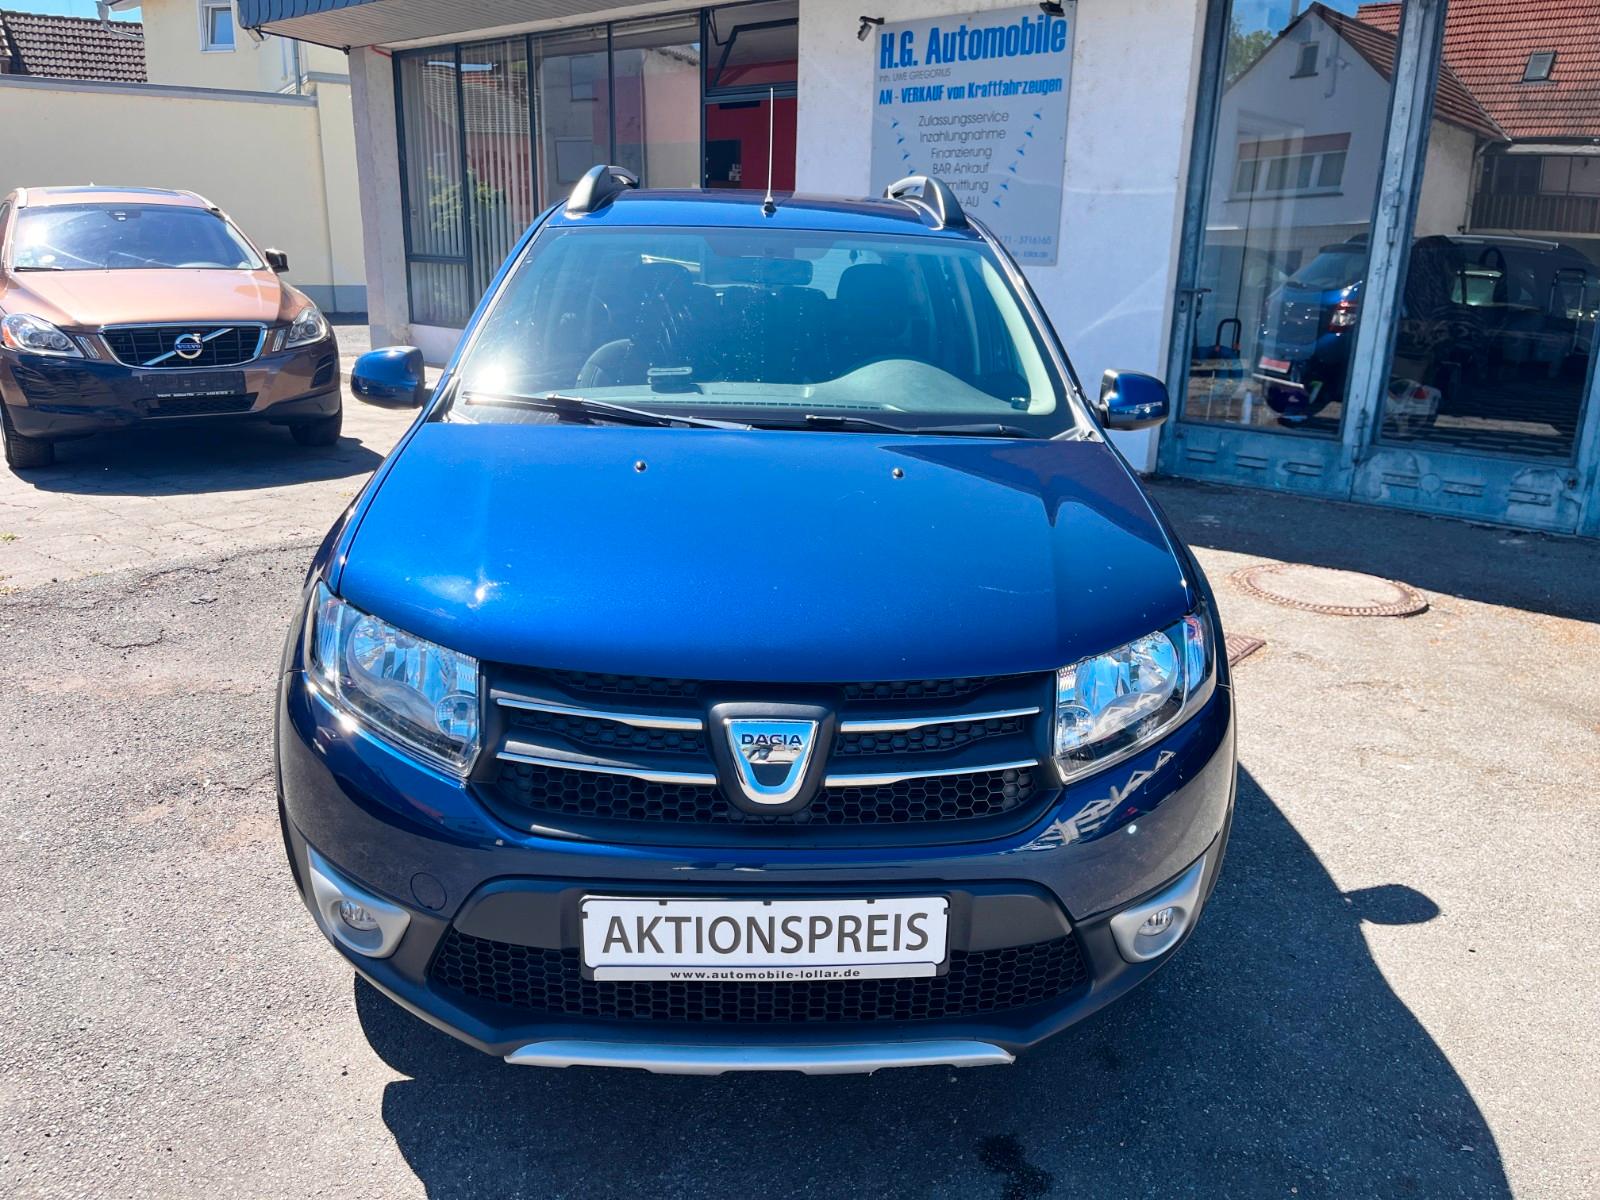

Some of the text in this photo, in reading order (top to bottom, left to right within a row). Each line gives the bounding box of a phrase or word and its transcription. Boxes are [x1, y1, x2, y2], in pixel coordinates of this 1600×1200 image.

[880, 14, 1067, 69] H.G. Automobile
[909, 68, 952, 80] GREGORIUS
[879, 89, 893, 105] AN
[901, 85, 945, 104] VERKAUF
[947, 86, 965, 100] von
[968, 78, 1062, 99] Kraftfahrzeugen
[918, 111, 1009, 127] Zulassungsservice
[920, 129, 1006, 143] Inzahlungnahme
[930, 147, 993, 160] Finanzierung
[932, 161, 990, 175] BAR Ankauf
[965, 195, 980, 208] AU
[741, 734, 802, 745] DACIA
[602, 912, 929, 955] AKTIONSPREIS
[670, 968, 860, 980] www.automobile-lollar.de
